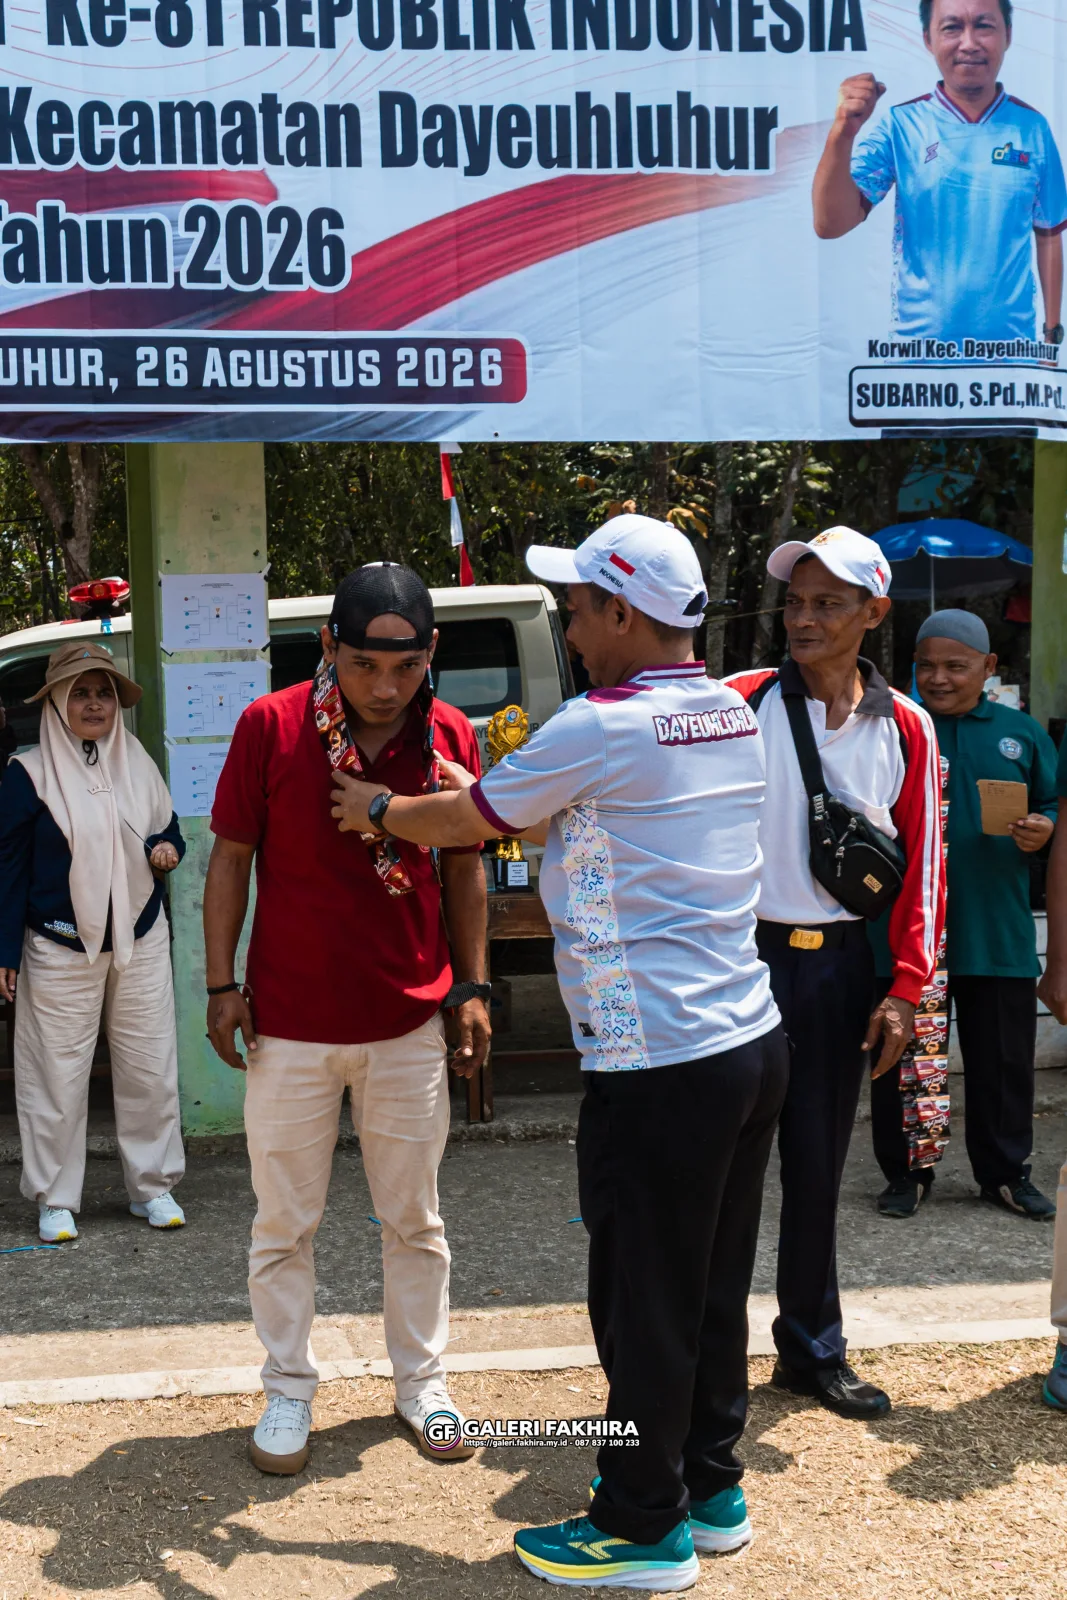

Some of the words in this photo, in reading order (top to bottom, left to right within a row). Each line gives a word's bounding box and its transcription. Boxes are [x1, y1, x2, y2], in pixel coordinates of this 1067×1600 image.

[244, 0, 535, 51] REPUBLIK
[551, 0, 867, 54] INDONESIA
[0, 86, 362, 168] Kecamatan
[379, 90, 778, 176] Dayeuhluhur
[0, 203, 168, 284] ahun
[183, 204, 346, 287] 2026
[136, 346, 188, 387] 26
[202, 347, 381, 388] AGUSTUS
[397, 347, 502, 387] 2026
[868, 339, 922, 358] Korwil
[926, 340, 960, 358] Kec.
[964, 339, 1060, 361] Dayeuhluhur
[856, 382, 964, 409] SUBARNO,
